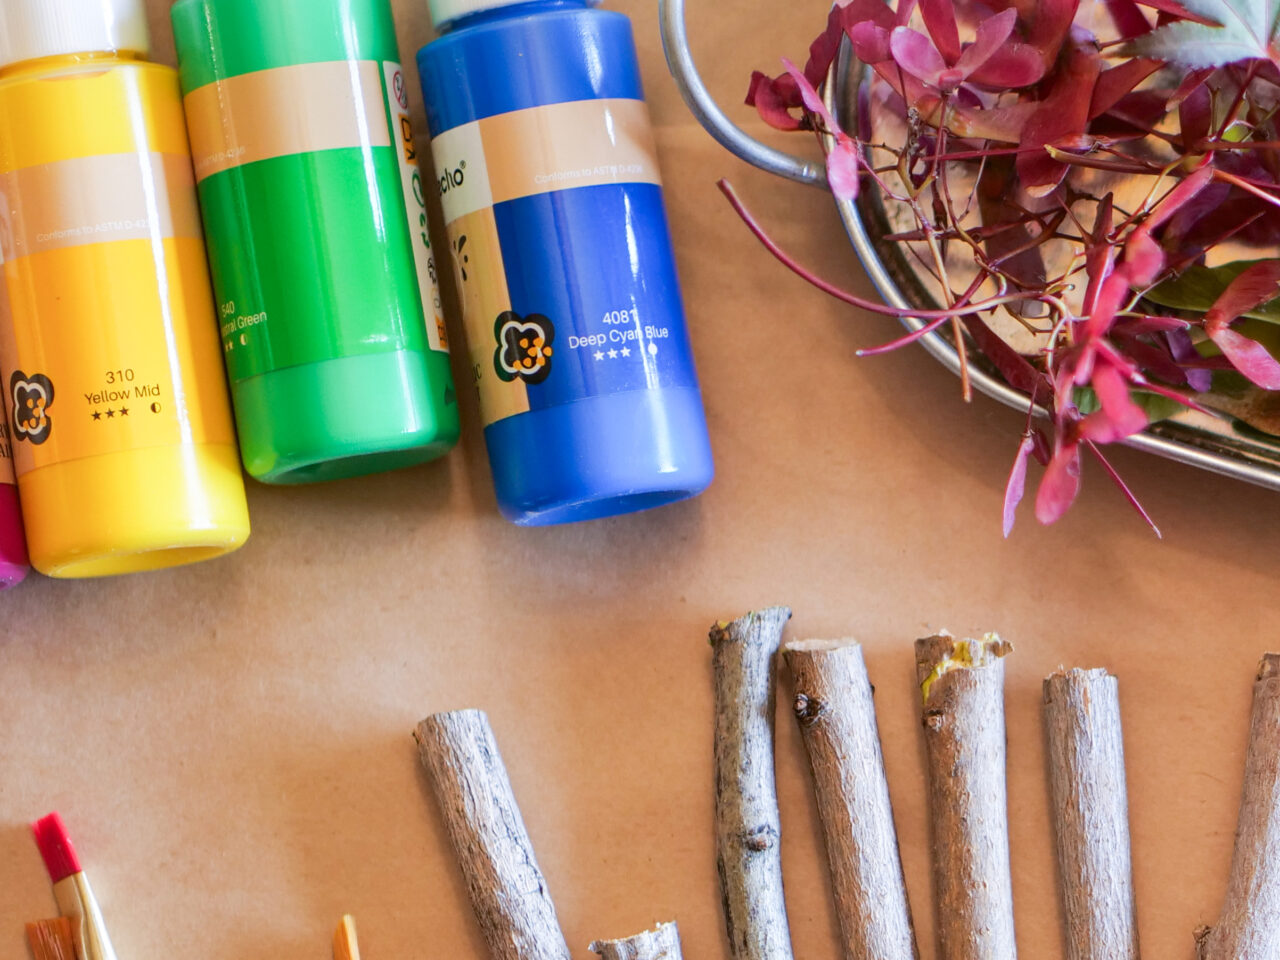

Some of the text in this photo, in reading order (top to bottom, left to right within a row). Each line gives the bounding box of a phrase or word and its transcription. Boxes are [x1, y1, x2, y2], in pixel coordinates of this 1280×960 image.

[237, 311, 268, 329] Green
[602, 309, 637, 324] 4081
[568, 325, 669, 349] Deep Cyan Blue
[105, 368, 134, 384] 310
[84, 383, 161, 405] Yellow Mid
